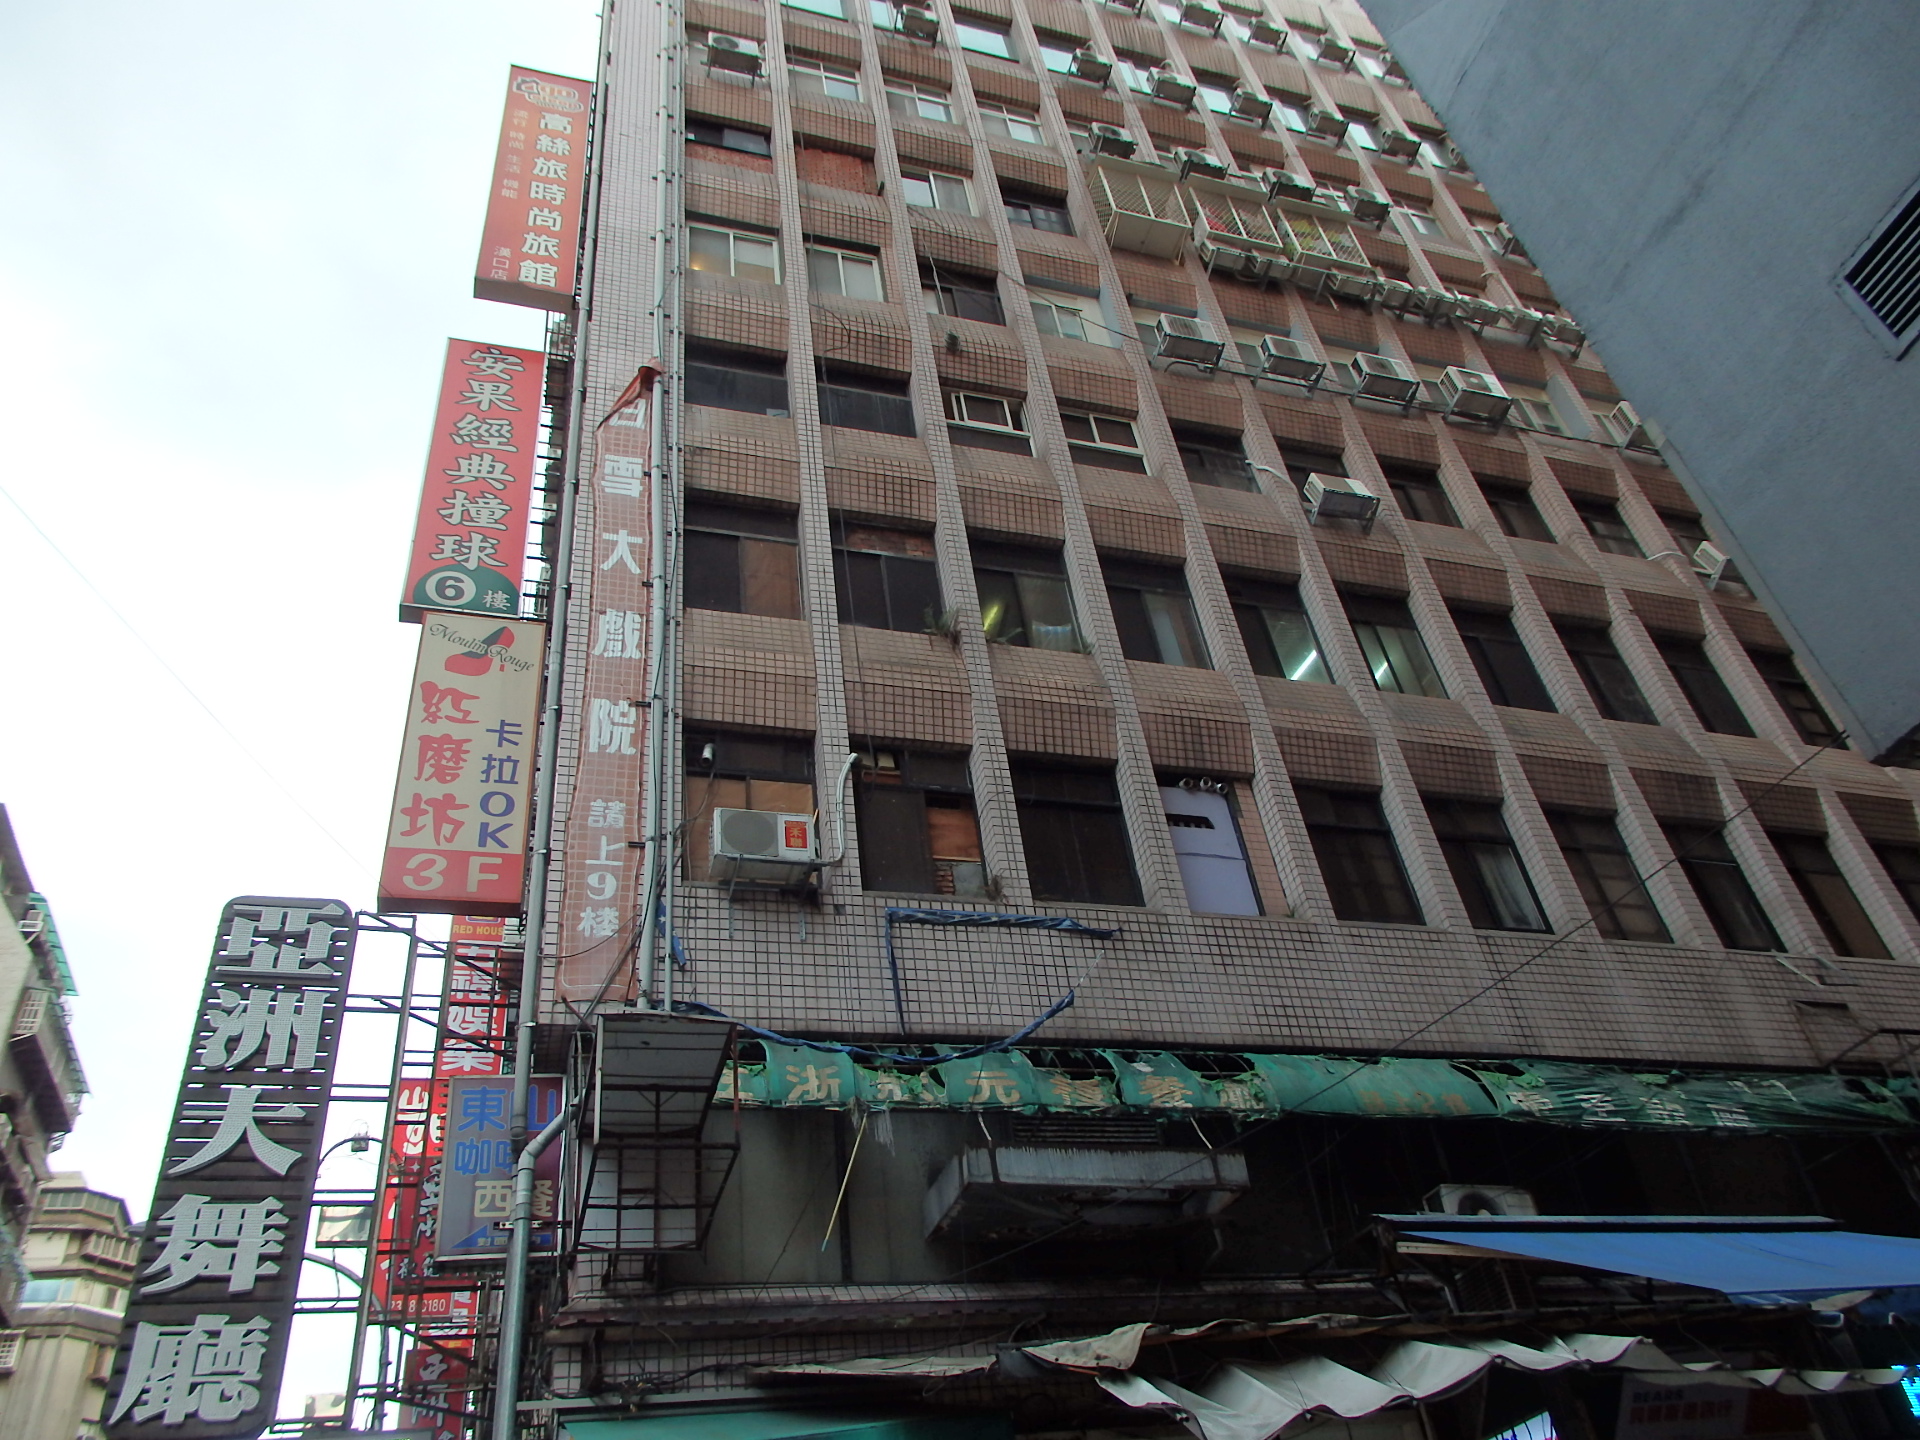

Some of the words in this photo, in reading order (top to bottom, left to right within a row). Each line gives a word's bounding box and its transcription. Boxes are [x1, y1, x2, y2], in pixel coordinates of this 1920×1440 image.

[517, 111, 573, 288] 高絲旅時尚旅館
[429, 346, 526, 571] 安果經典撞球
[428, 622, 487, 655] Moulin
[487, 646, 535, 672] Rouge
[400, 680, 481, 847] 紅磨坊
[477, 719, 524, 849] 卡拉OK
[453, 924, 473, 934] RED
[108, 902, 348, 1426] 亞洲大舞廳
